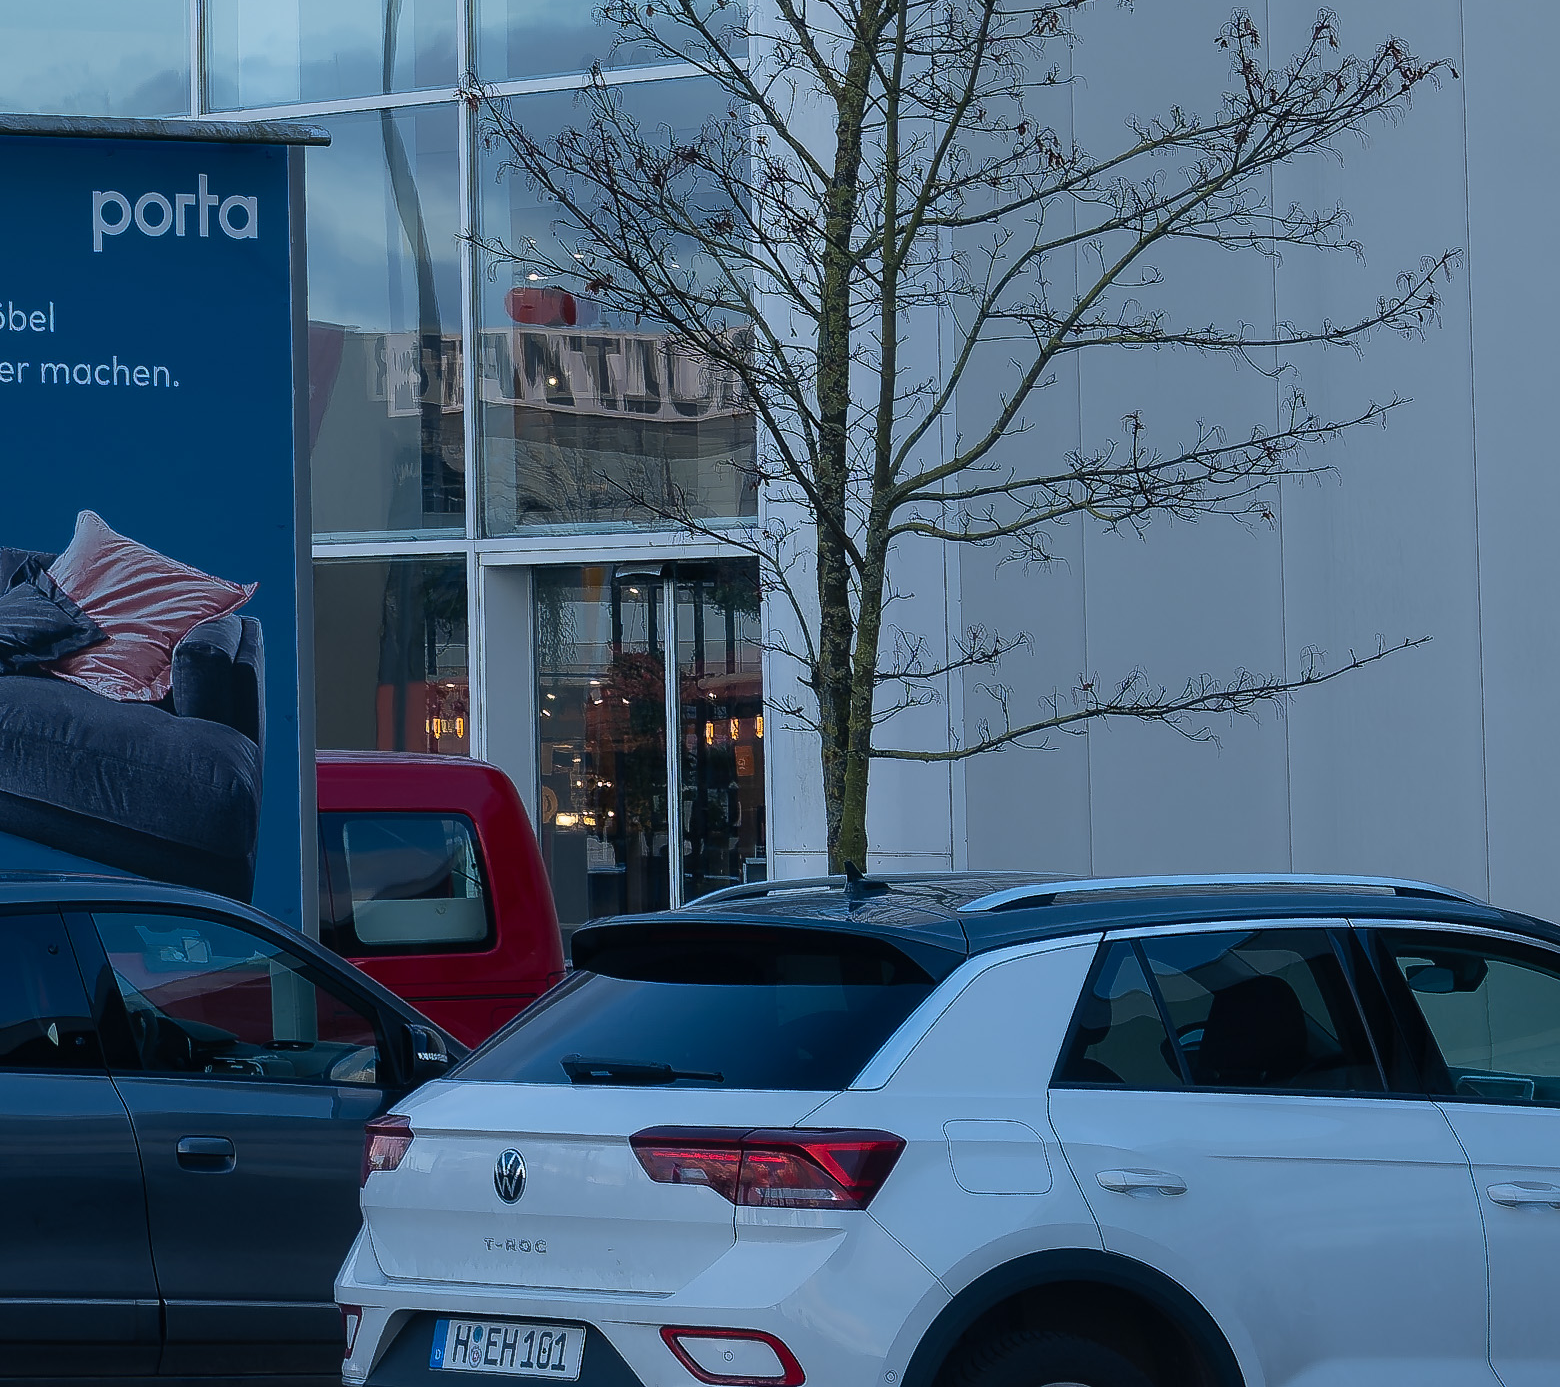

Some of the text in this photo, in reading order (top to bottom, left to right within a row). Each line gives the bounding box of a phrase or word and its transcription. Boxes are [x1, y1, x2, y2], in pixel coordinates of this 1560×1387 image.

[92, 173, 258, 252] porta
[40, 356, 180, 388] machen.
[484, 1237, 547, 1254] T-ROC
[452, 1325, 471, 1364] H
[484, 1328, 519, 1368] EH
[520, 1330, 568, 1372] 101
